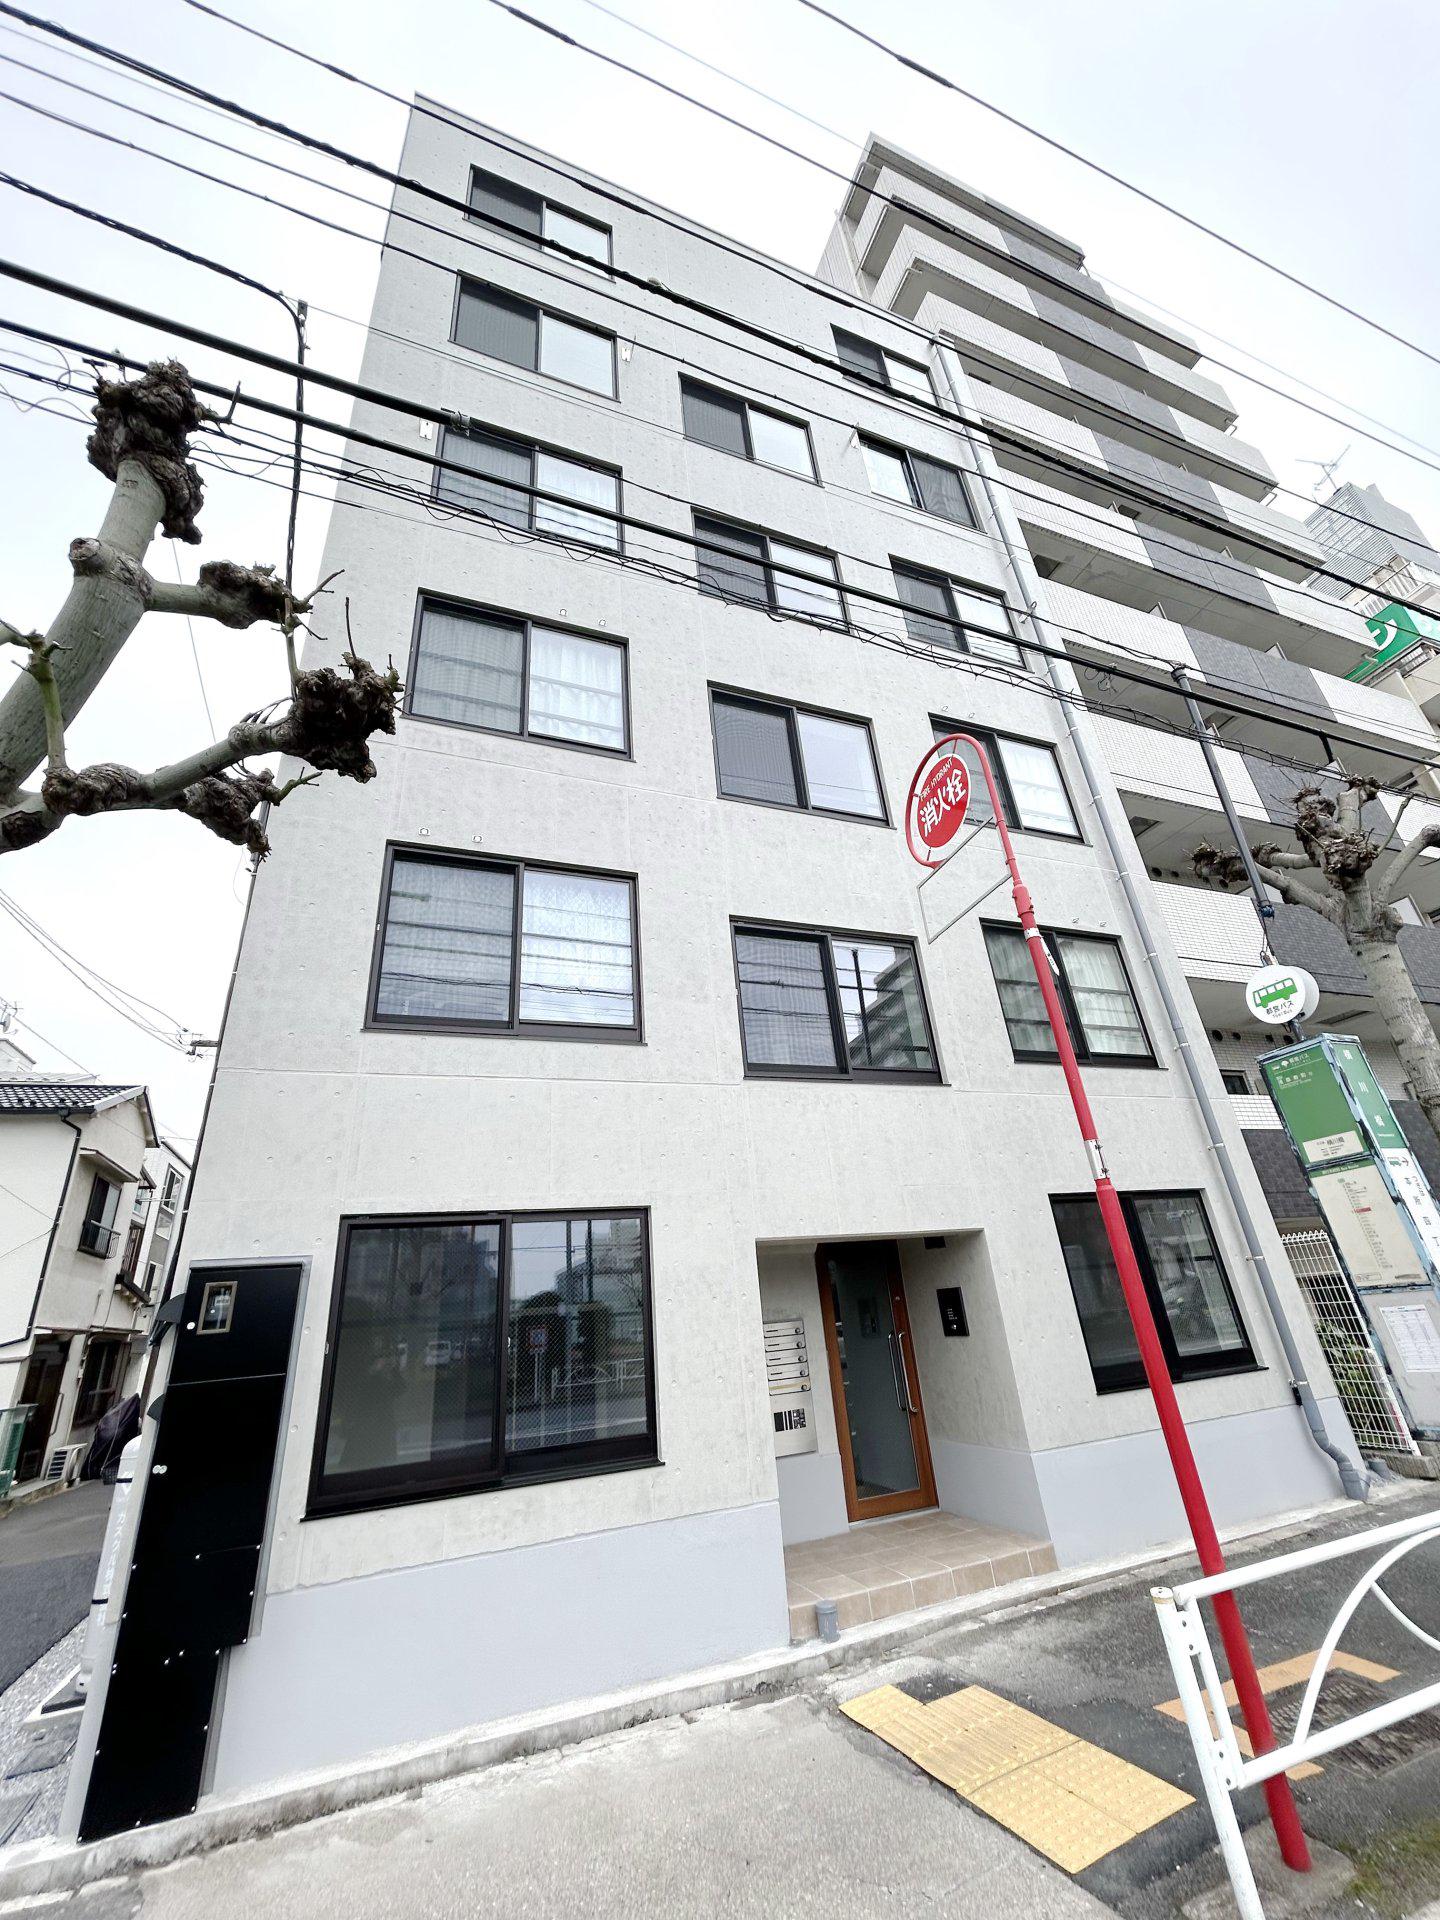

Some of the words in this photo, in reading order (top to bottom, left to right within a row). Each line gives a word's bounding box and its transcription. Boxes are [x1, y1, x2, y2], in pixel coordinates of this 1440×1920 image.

[930, 758, 953, 788] HYDRANT
[919, 768, 967, 837] 消火栓
